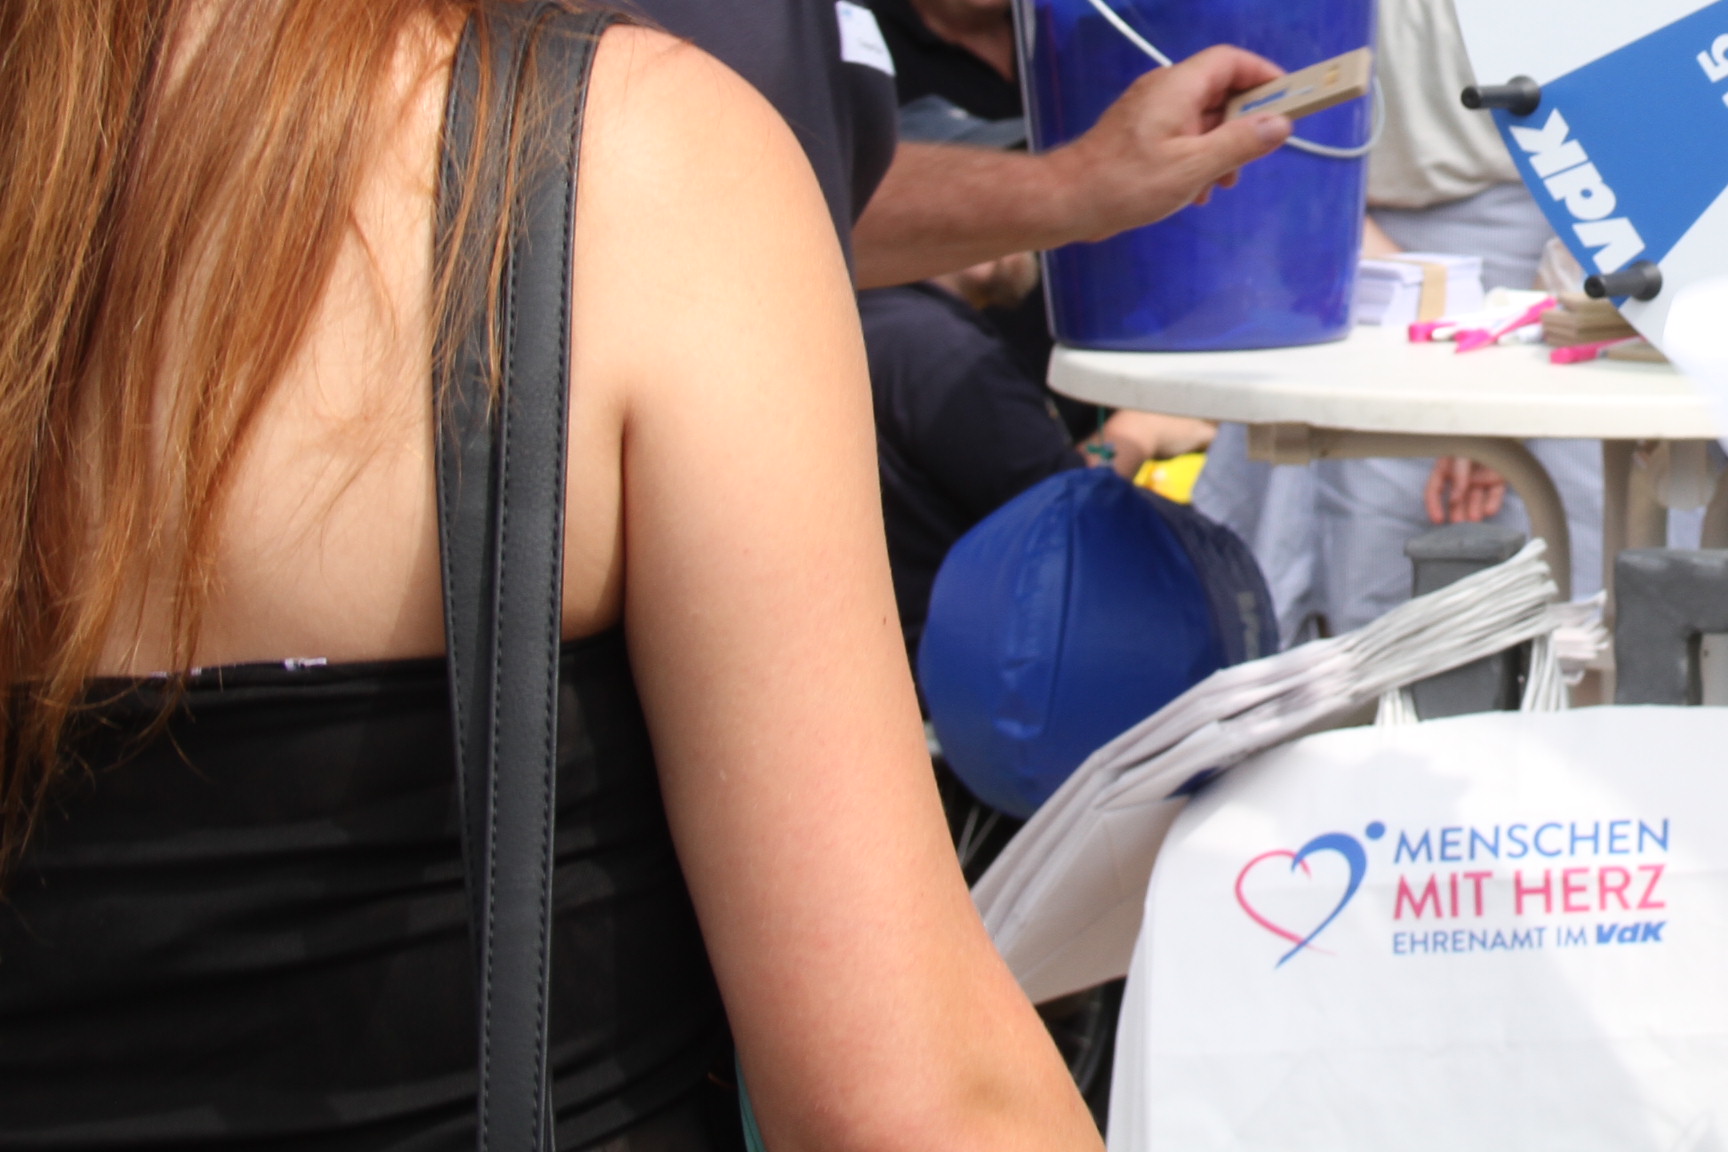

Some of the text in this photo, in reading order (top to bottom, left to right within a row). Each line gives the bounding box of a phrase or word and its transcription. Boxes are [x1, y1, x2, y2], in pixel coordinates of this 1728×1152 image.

[1509, 108, 1646, 274] VdK
[1393, 818, 1670, 864] MENSCHEN
[1392, 863, 1667, 921] MIT HERZ
[1392, 920, 1668, 955] EHRENAMT IM VdK
